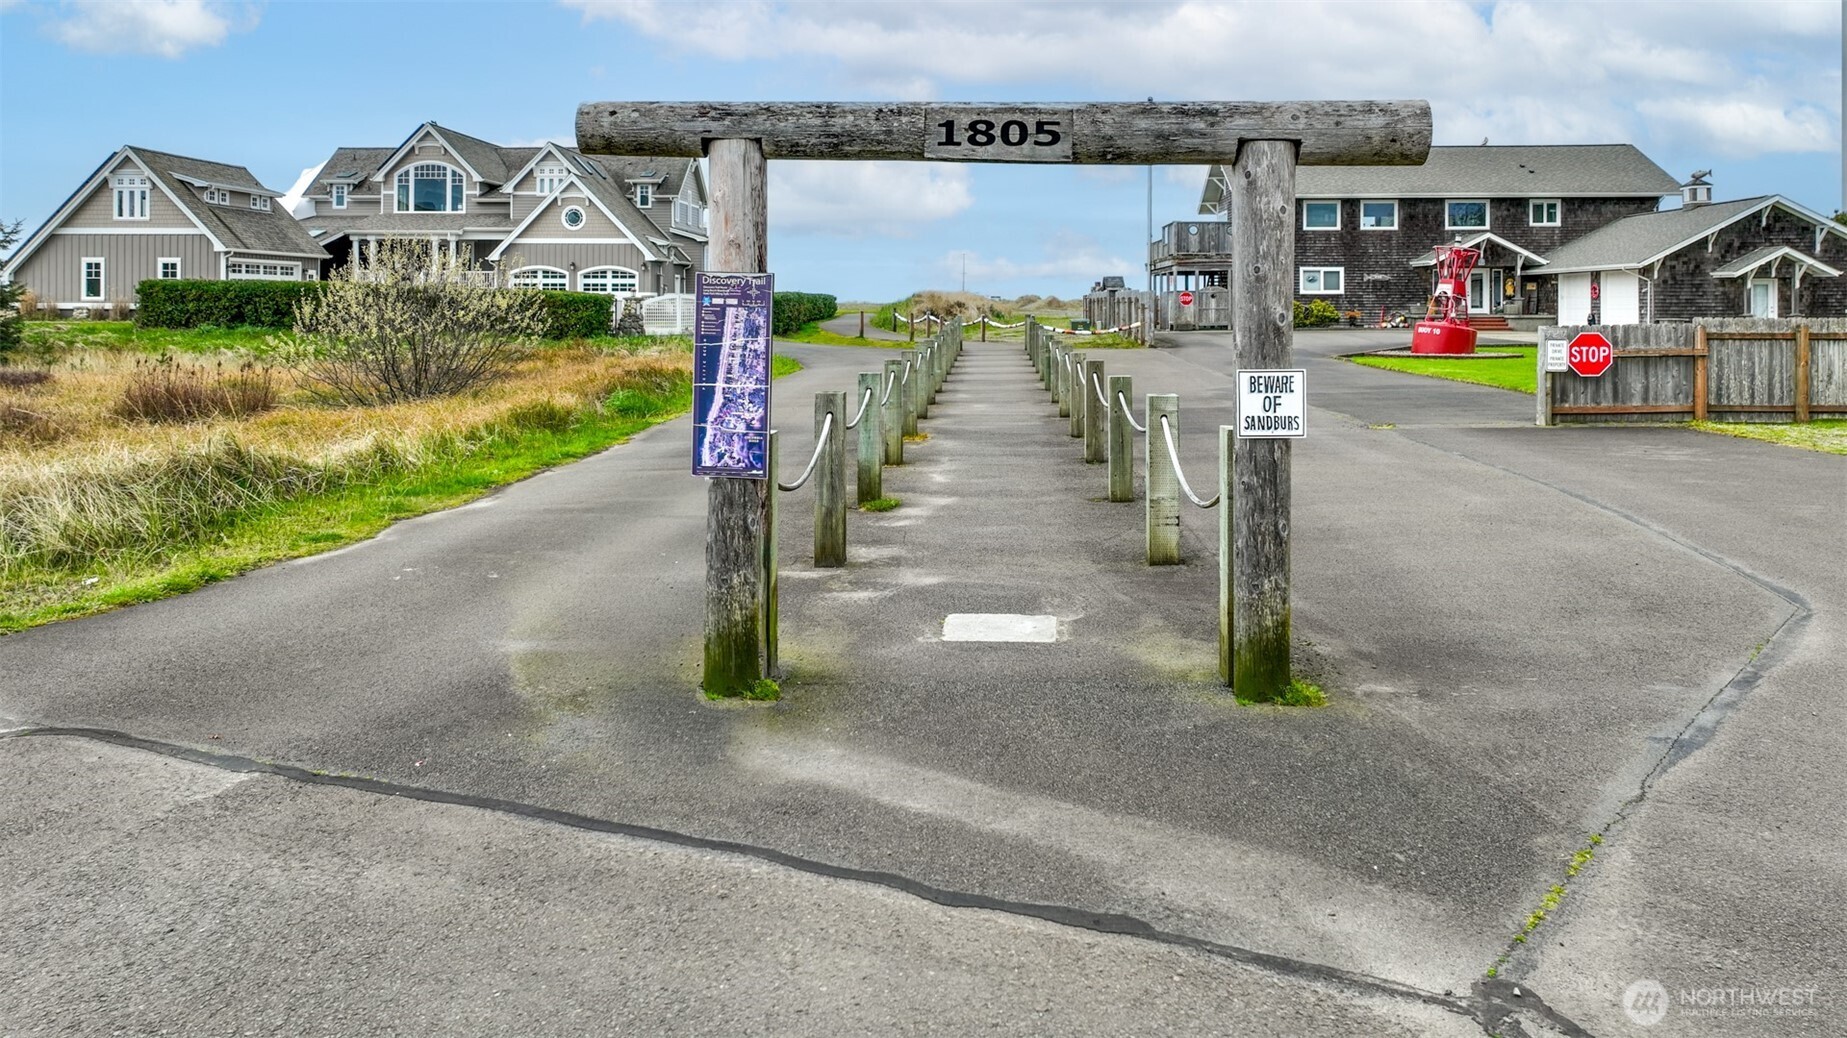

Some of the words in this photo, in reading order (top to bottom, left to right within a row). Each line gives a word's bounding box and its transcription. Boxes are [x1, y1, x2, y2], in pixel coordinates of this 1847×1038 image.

[937, 119, 1061, 146] 1805
[702, 276, 746, 286] Discovery
[748, 277, 766, 285] Trail
[1571, 346, 1610, 363] STOP
[1249, 375, 1295, 394] BEWARE
[1263, 395, 1282, 413] OF
[1244, 415, 1300, 431] SANDBURS
